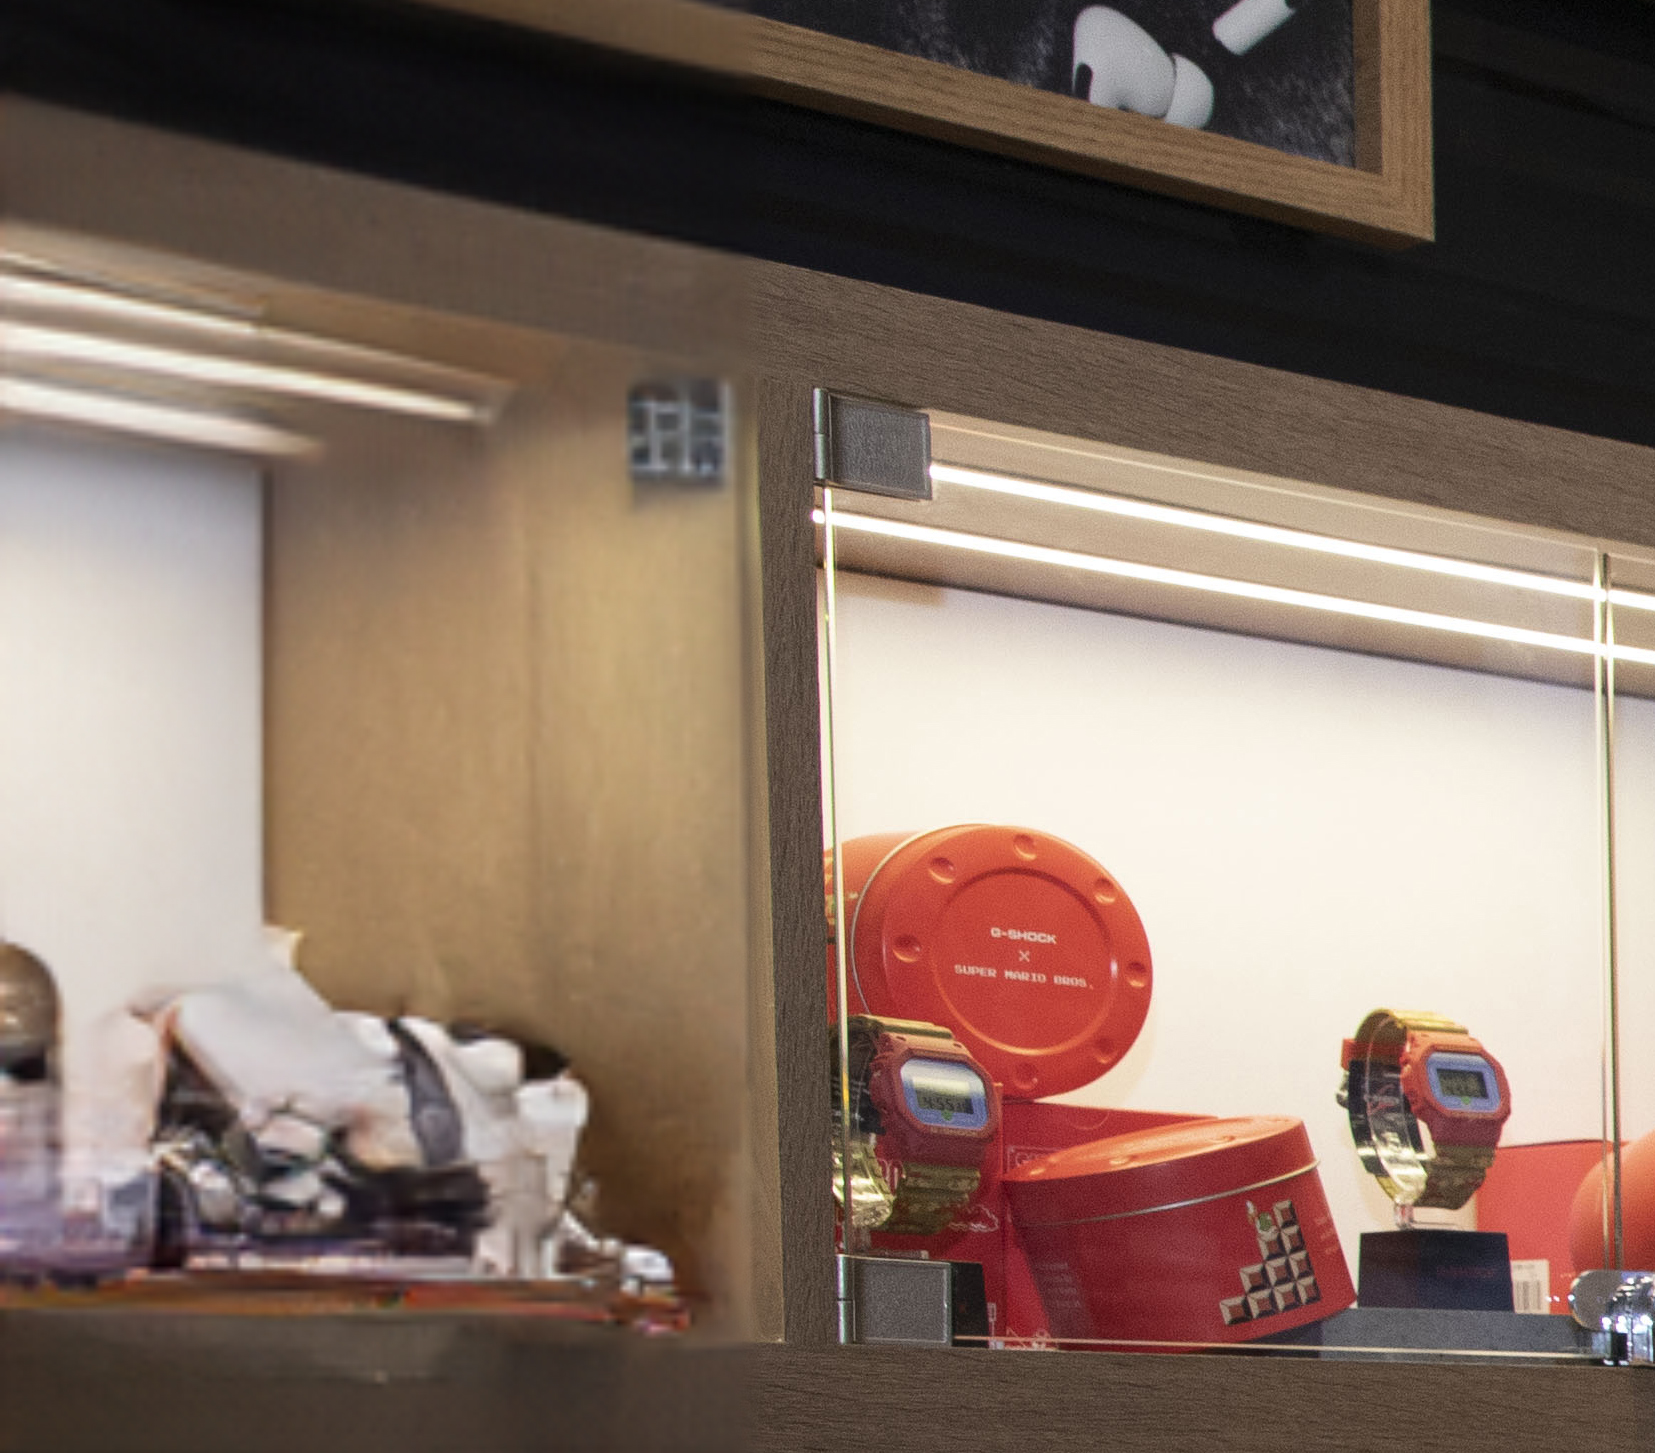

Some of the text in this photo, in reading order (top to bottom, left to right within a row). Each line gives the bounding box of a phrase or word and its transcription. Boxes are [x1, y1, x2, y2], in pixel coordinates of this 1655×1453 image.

[990, 927, 1057, 944] G-SHOCK
[954, 964, 997, 978] SUPER
[1004, 969, 1047, 983] MARIO
